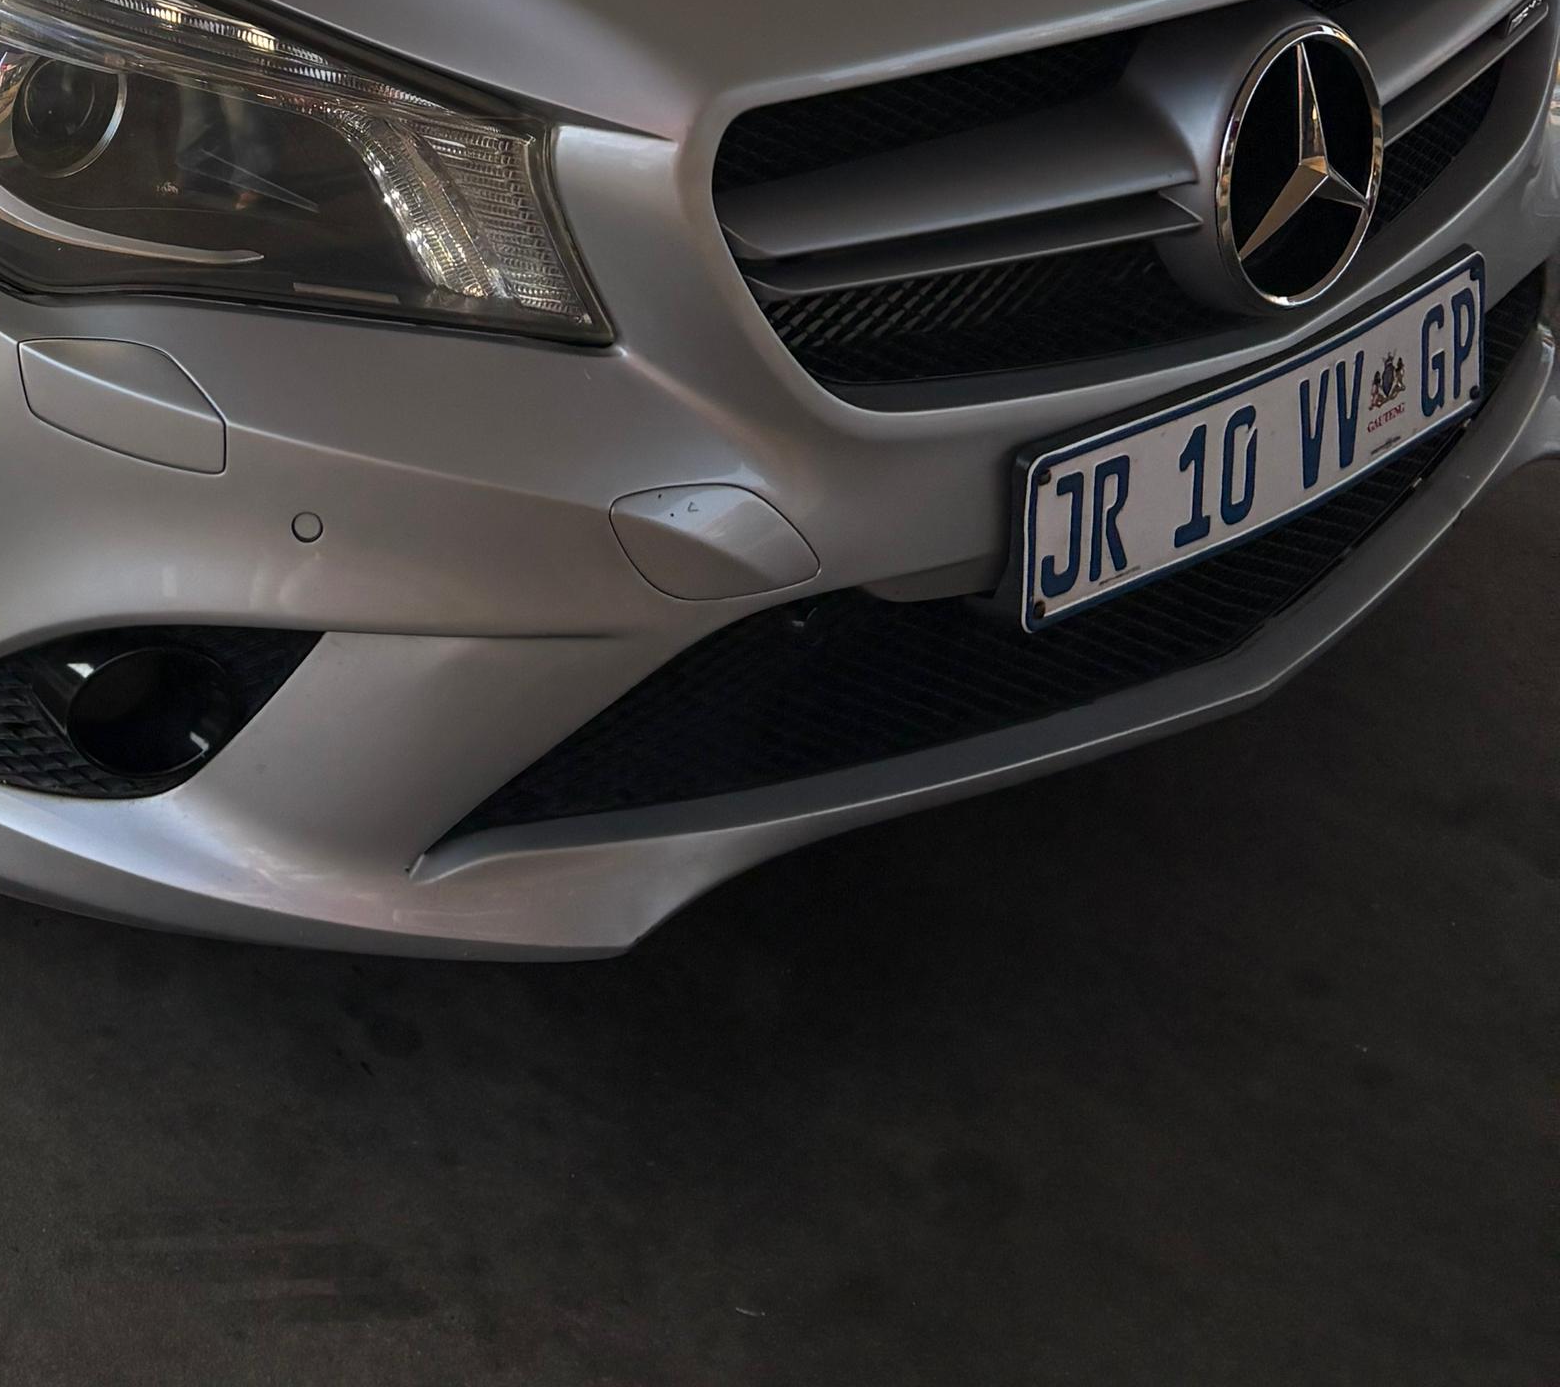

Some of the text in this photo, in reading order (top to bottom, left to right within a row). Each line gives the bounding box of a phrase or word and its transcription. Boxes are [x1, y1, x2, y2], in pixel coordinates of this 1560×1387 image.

[1040, 287, 1477, 598] JR 10 VV GP
[1367, 402, 1406, 433] GAUTENG
